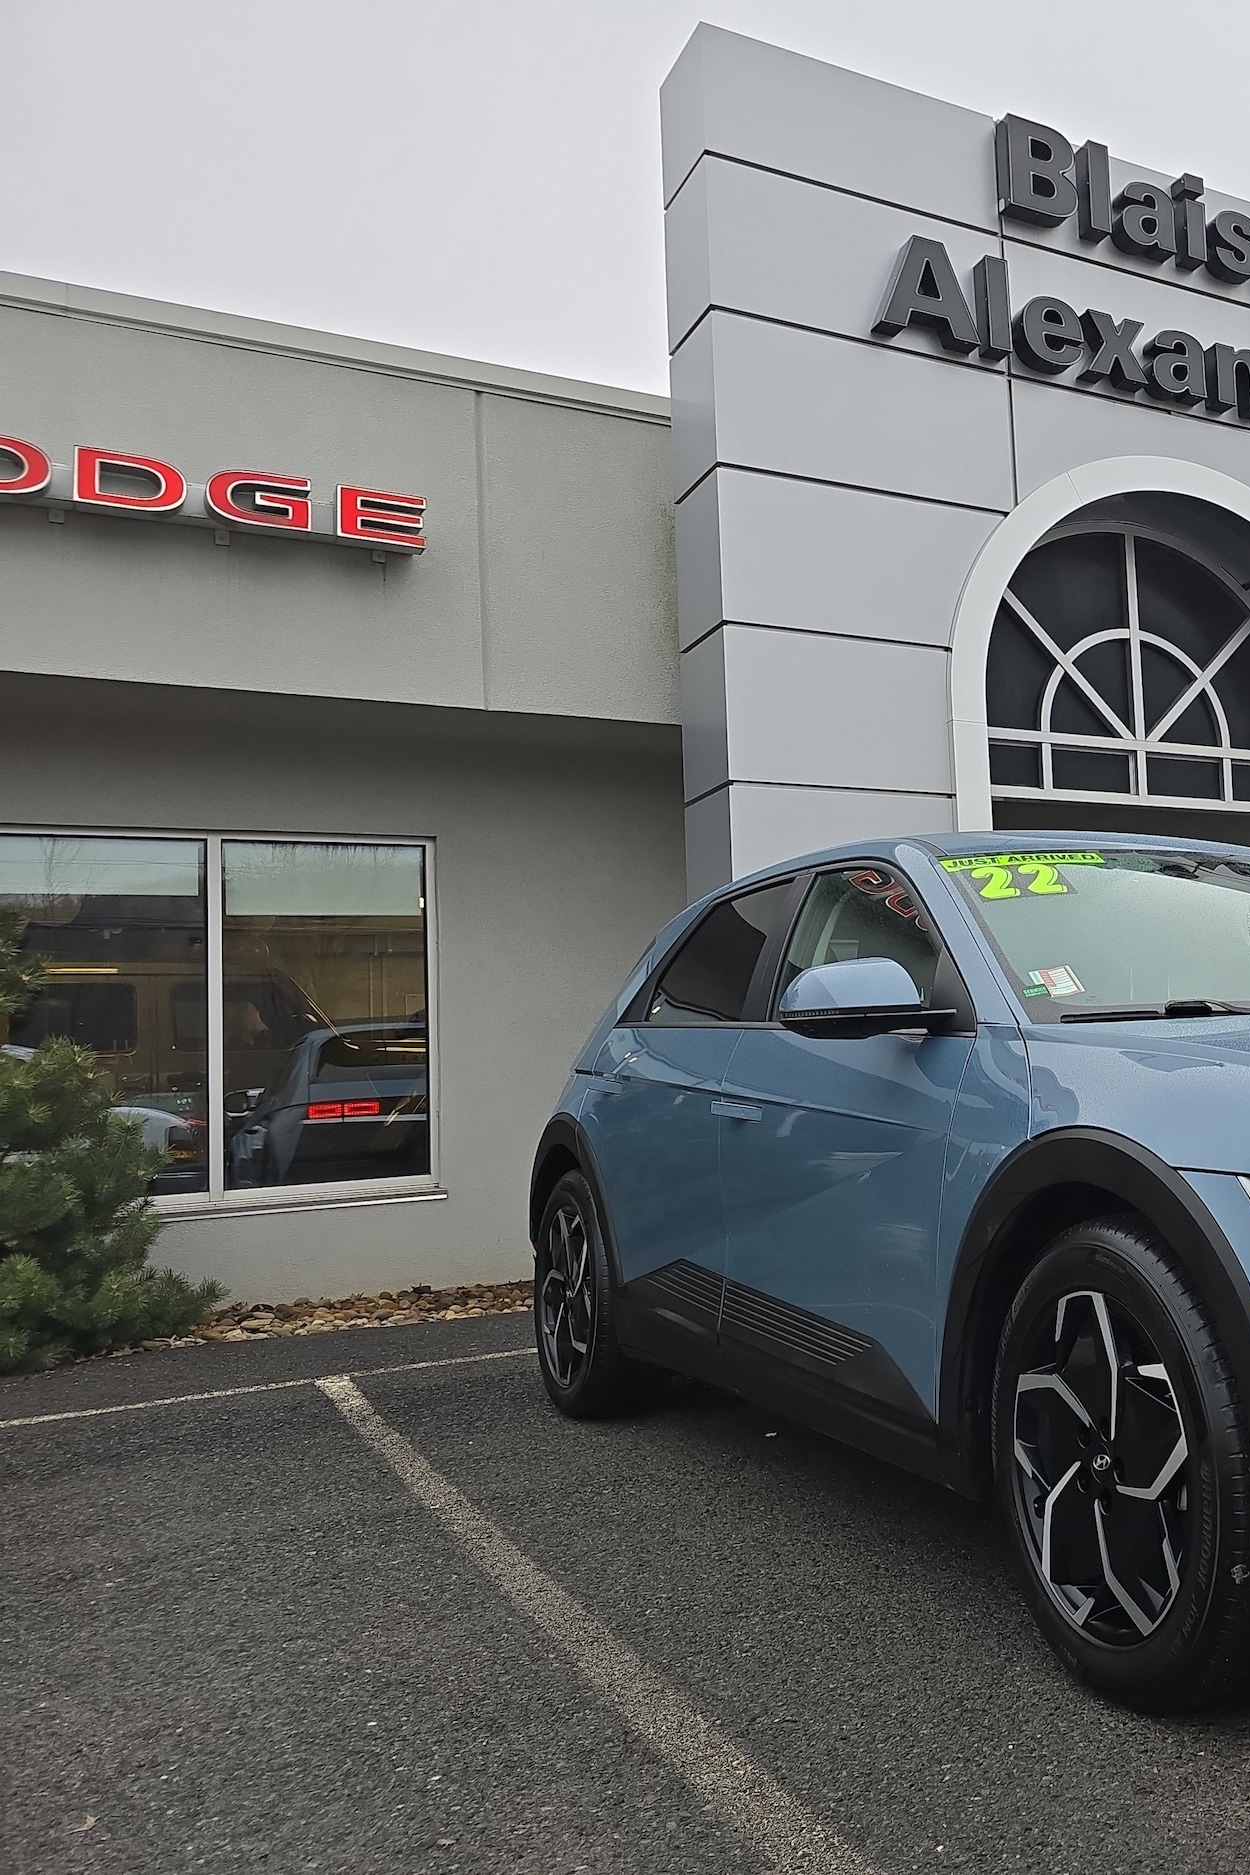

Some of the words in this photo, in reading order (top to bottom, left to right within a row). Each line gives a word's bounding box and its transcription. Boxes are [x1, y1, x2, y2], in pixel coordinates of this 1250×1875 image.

[947, 856, 1000, 868] JUST
[1008, 852, 1099, 863] ARRIVED
[971, 864, 1068, 899] 22
